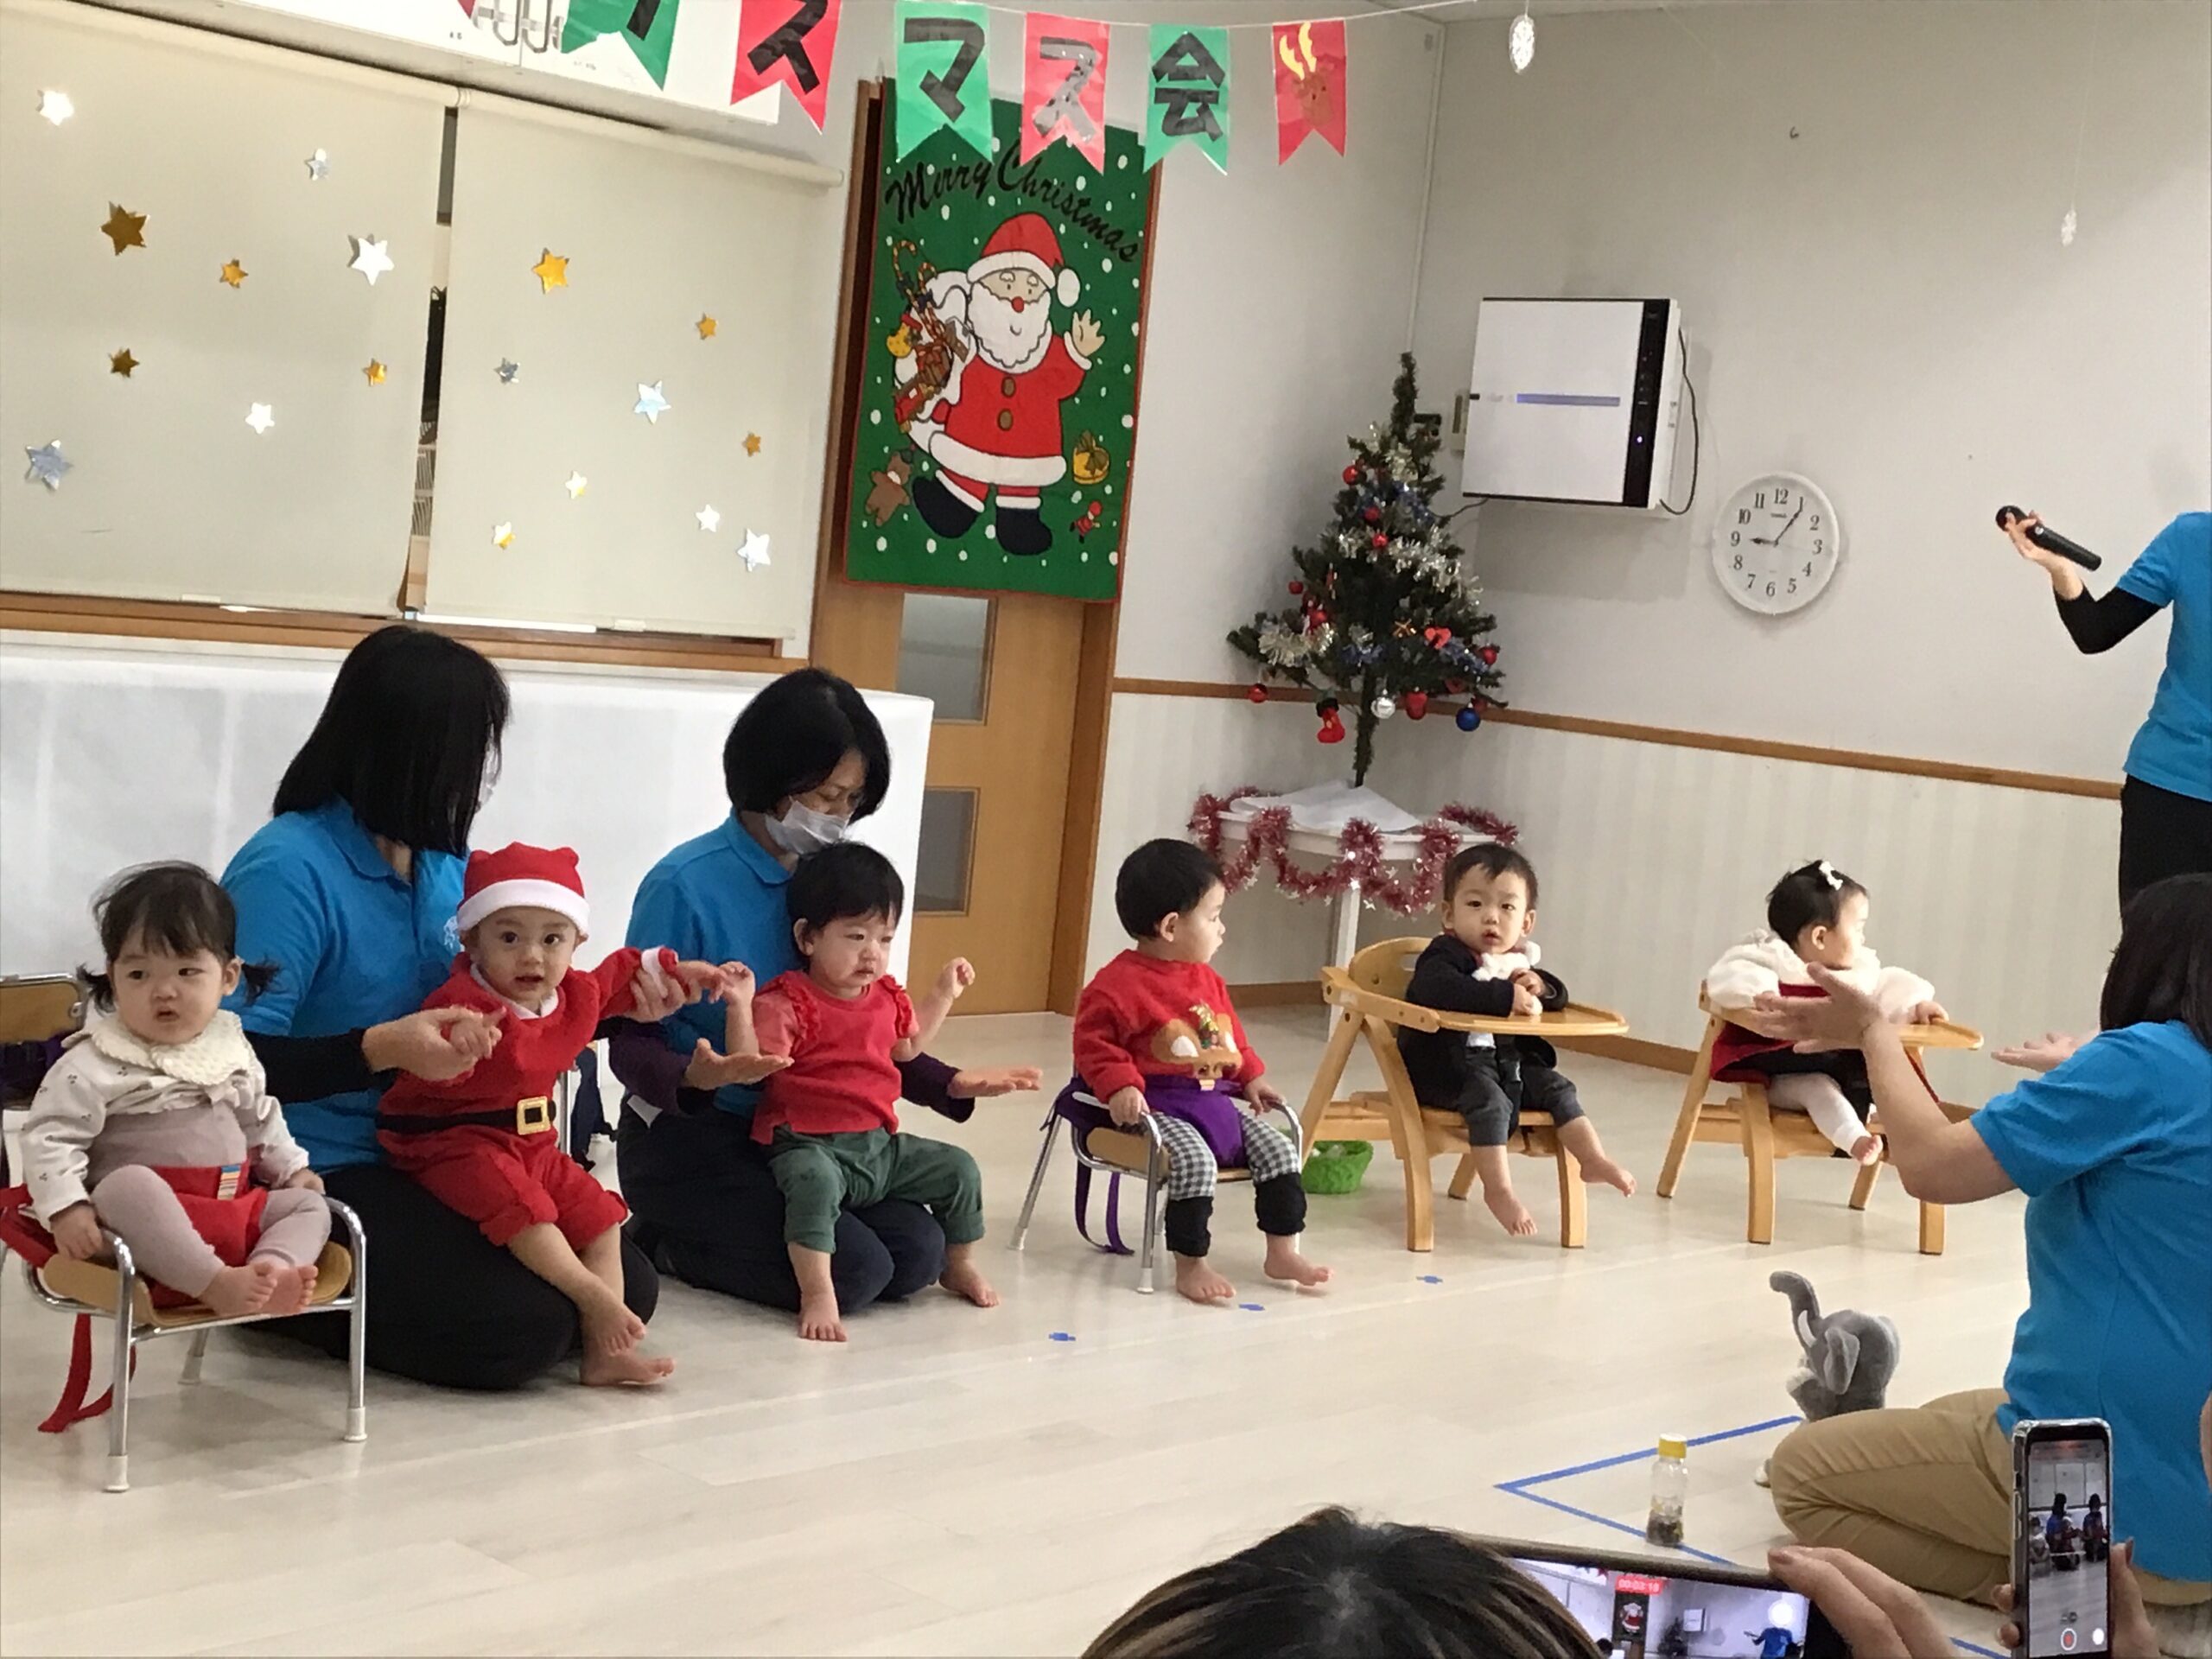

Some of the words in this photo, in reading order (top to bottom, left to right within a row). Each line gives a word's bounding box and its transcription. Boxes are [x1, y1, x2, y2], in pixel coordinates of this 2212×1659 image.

[885, 161, 992, 224] Merry
[998, 138, 1139, 262] Christmas
[1754, 493, 1764, 509] 11
[1773, 488, 1789, 505] 12
[1738, 509, 1751, 524] 10
[1809, 515, 1820, 531] 2
[1731, 531, 1740, 547] 9
[1812, 539, 1822, 555] 3
[1733, 554, 1743, 570] 8
[1802, 562, 1812, 576] 4
[1747, 573, 1756, 588] 7
[1787, 578, 1796, 594] 5
[1765, 582, 1776, 597] 6
